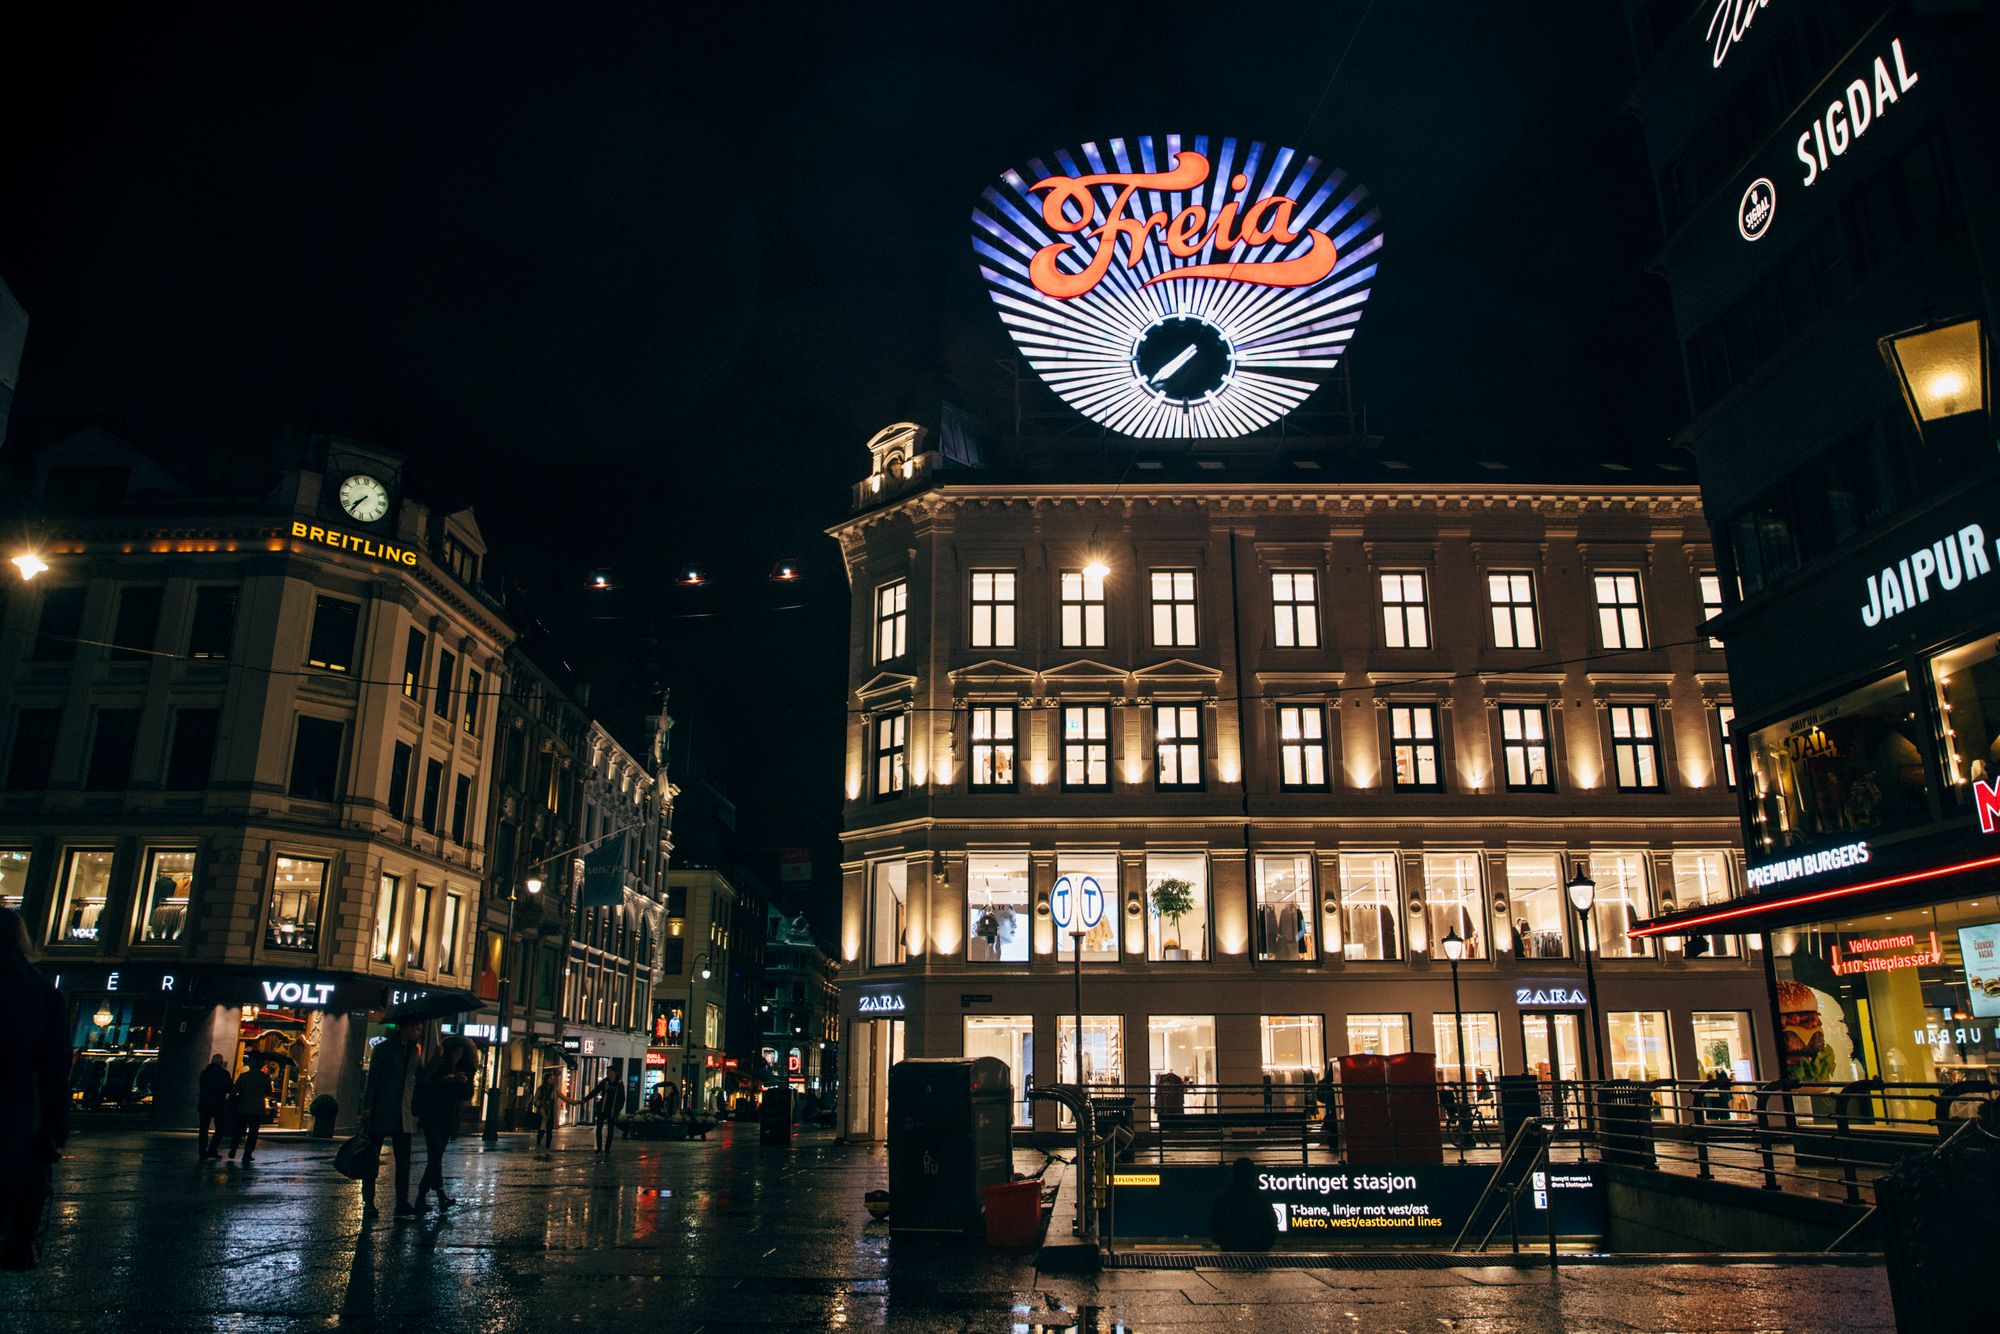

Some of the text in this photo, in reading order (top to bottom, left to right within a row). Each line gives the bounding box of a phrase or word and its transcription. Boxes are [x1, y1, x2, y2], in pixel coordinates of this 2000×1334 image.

[1797, 37, 1918, 187] SIGDAL
[1745, 196, 1770, 228] SIGDAL
[1027, 150, 1338, 299] Freia
[291, 521, 417, 566] BREITLING
[1861, 523, 1991, 627] JAIPUR
[1747, 841, 1869, 888] PREMIUM BURGERS
[72, 928, 98, 939] VOLT
[1848, 935, 1915, 954] Velkommen
[1841, 960, 1860, 974] 110
[262, 981, 334, 1004] VOLT
[859, 995, 905, 1011] ZARA
[1516, 989, 1587, 1004] ZARA
[1258, 1172, 1417, 1194] Stortinget stasjon
[1290, 1203, 1430, 1218] T-bane, linjer mot vest/øst
[1291, 1216, 1443, 1228] Metro, west/eastbound lines
